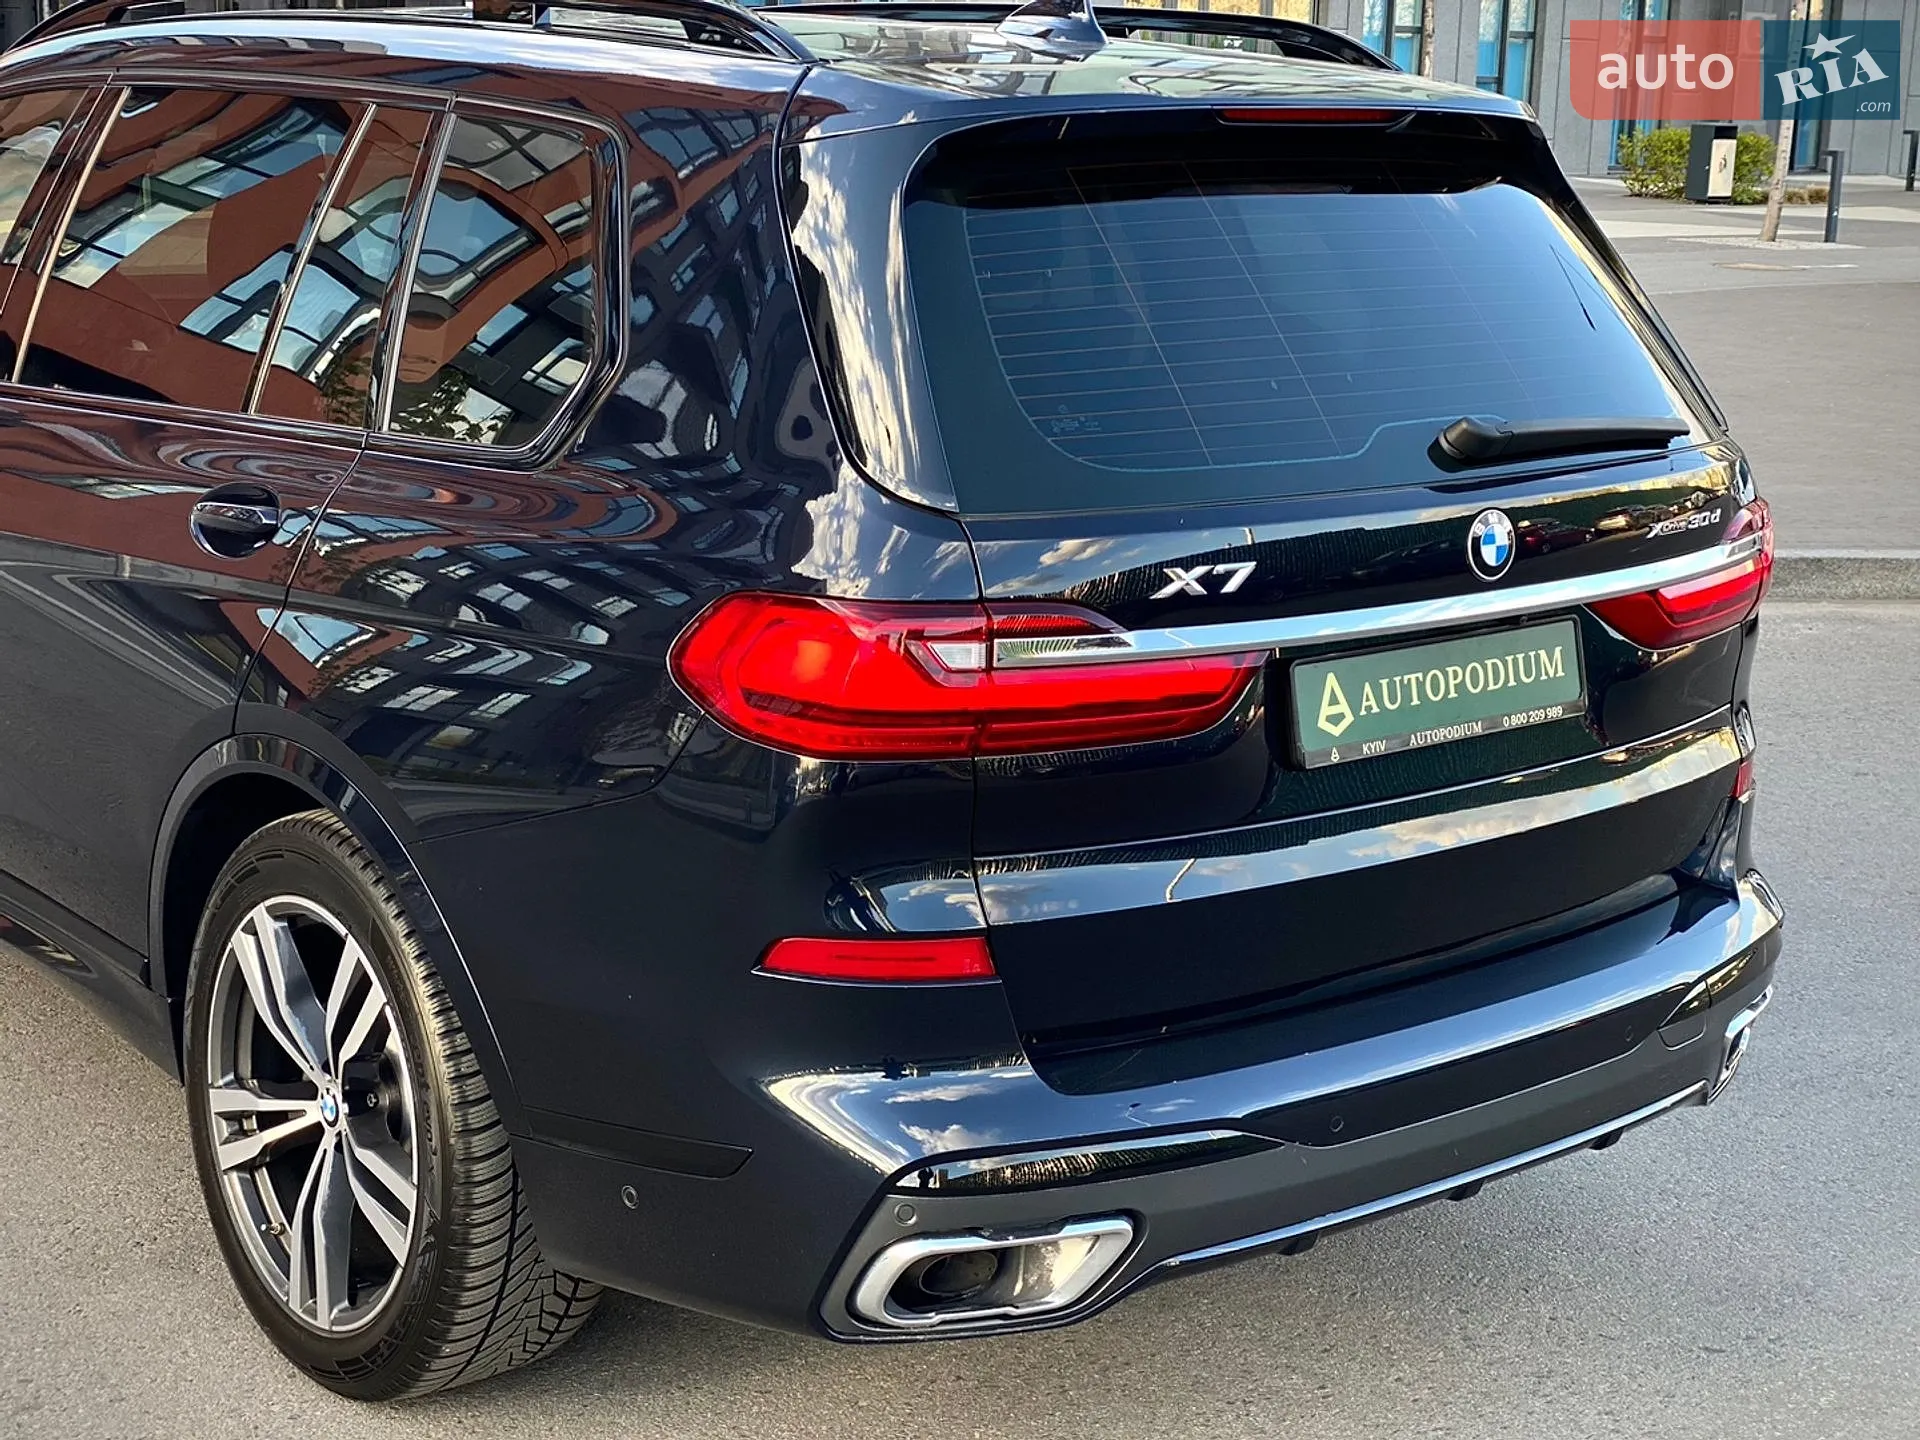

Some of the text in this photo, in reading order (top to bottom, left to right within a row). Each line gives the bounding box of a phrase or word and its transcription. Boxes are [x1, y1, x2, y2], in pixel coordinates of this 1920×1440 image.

[1149, 561, 1257, 599] X7
[1360, 646, 1565, 716] AUTOPODIUM
[1362, 739, 1387, 755] KYIV
[1409, 720, 1483, 747] AUTOPODIUM
[1510, 712, 1528, 725] 800
[1529, 708, 1546, 722] 209
[1546, 705, 1563, 719] 989
